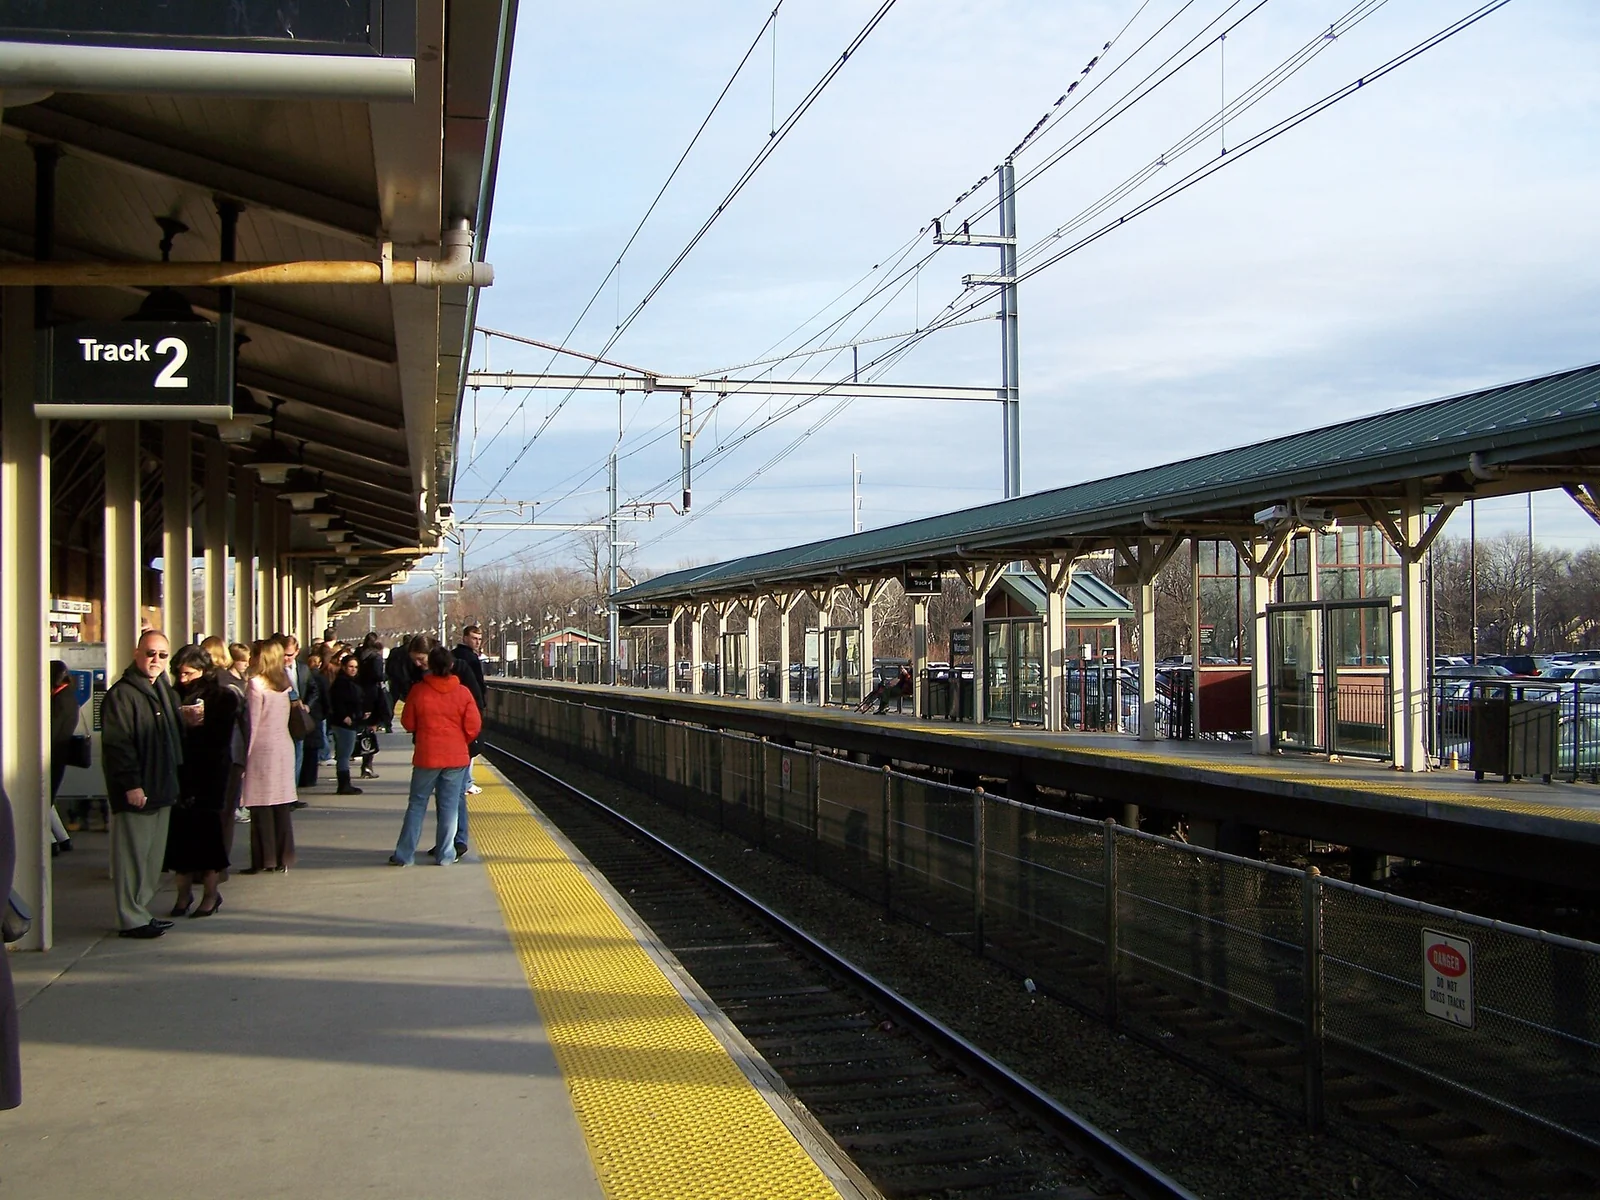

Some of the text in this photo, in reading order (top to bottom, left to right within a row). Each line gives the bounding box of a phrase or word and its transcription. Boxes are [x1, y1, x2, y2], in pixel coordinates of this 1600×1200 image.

[79, 337, 188, 388] Track 2
[378, 592, 386, 602] 2
[1433, 950, 1460, 971] DANGER
[1436, 976, 1457, 992] DO NOT
